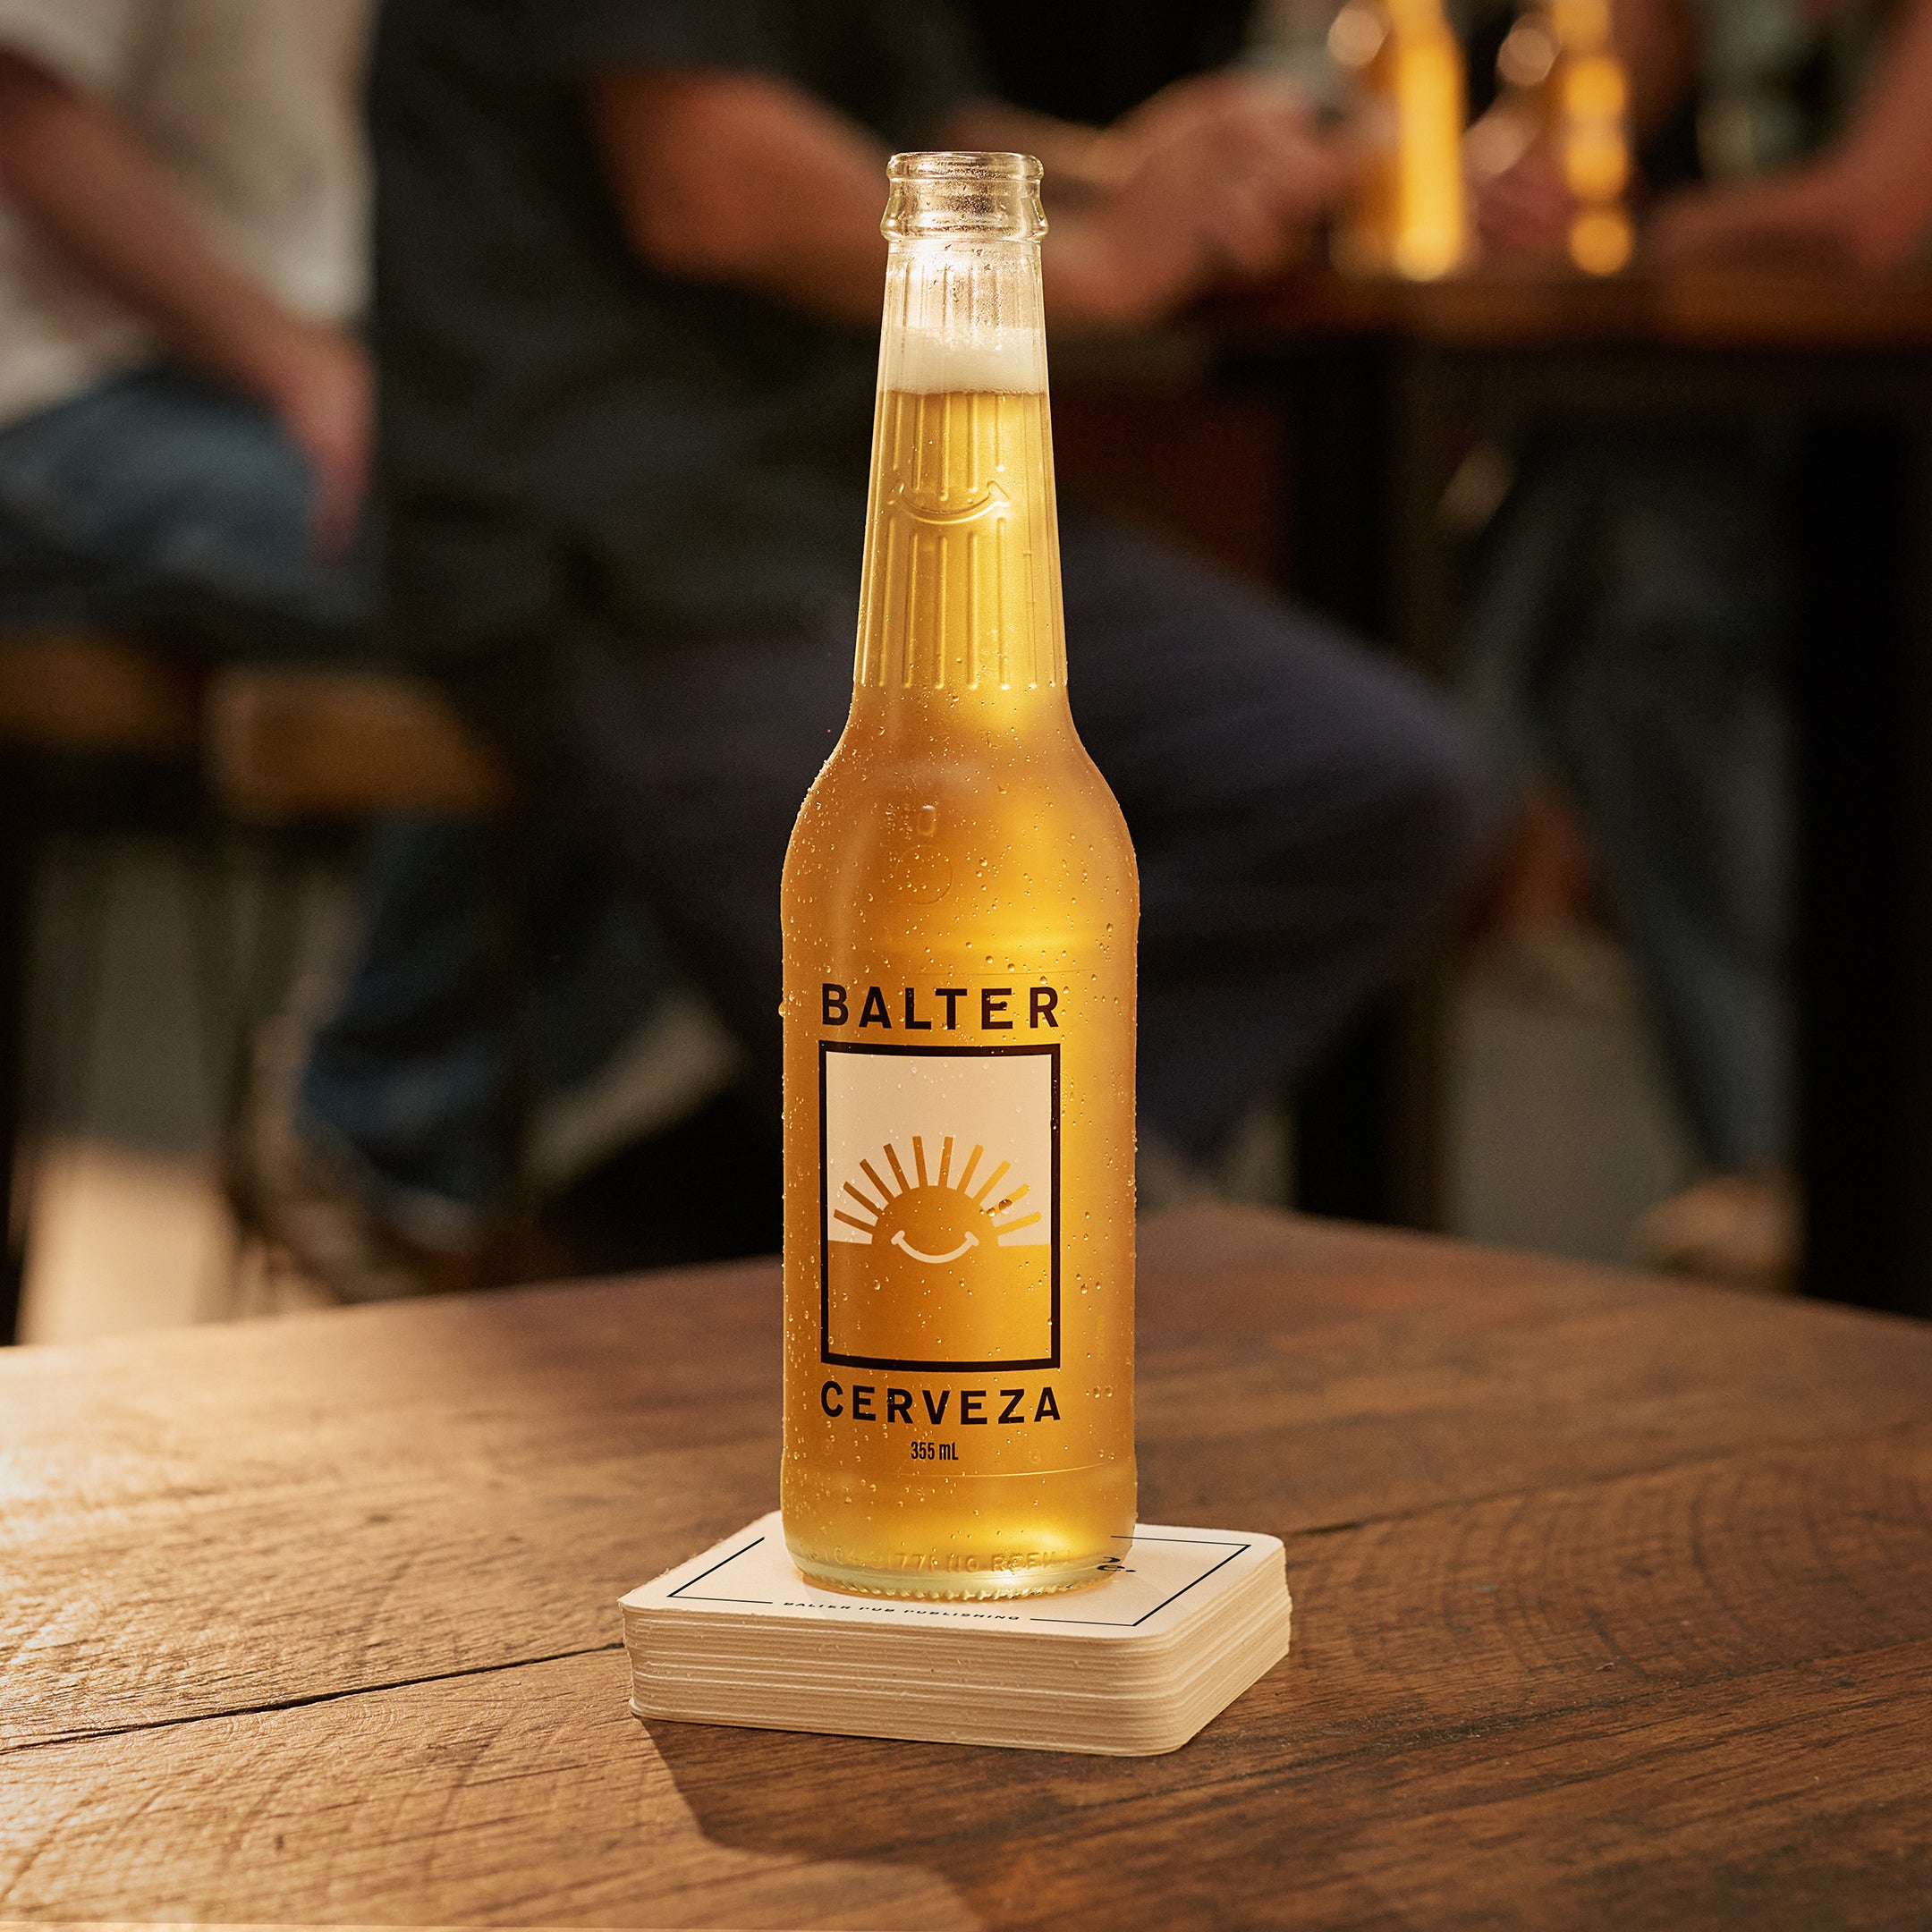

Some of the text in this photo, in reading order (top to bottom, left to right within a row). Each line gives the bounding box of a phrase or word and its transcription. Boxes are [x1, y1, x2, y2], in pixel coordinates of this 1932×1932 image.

[822, 982, 1059, 1030] BALTER
[820, 1380, 1061, 1425] CERVEZA
[910, 1441, 936, 1461] 355
[783, 1602, 852, 1610] BALTER
[903, 1609, 1020, 1621] PUBLISHING
